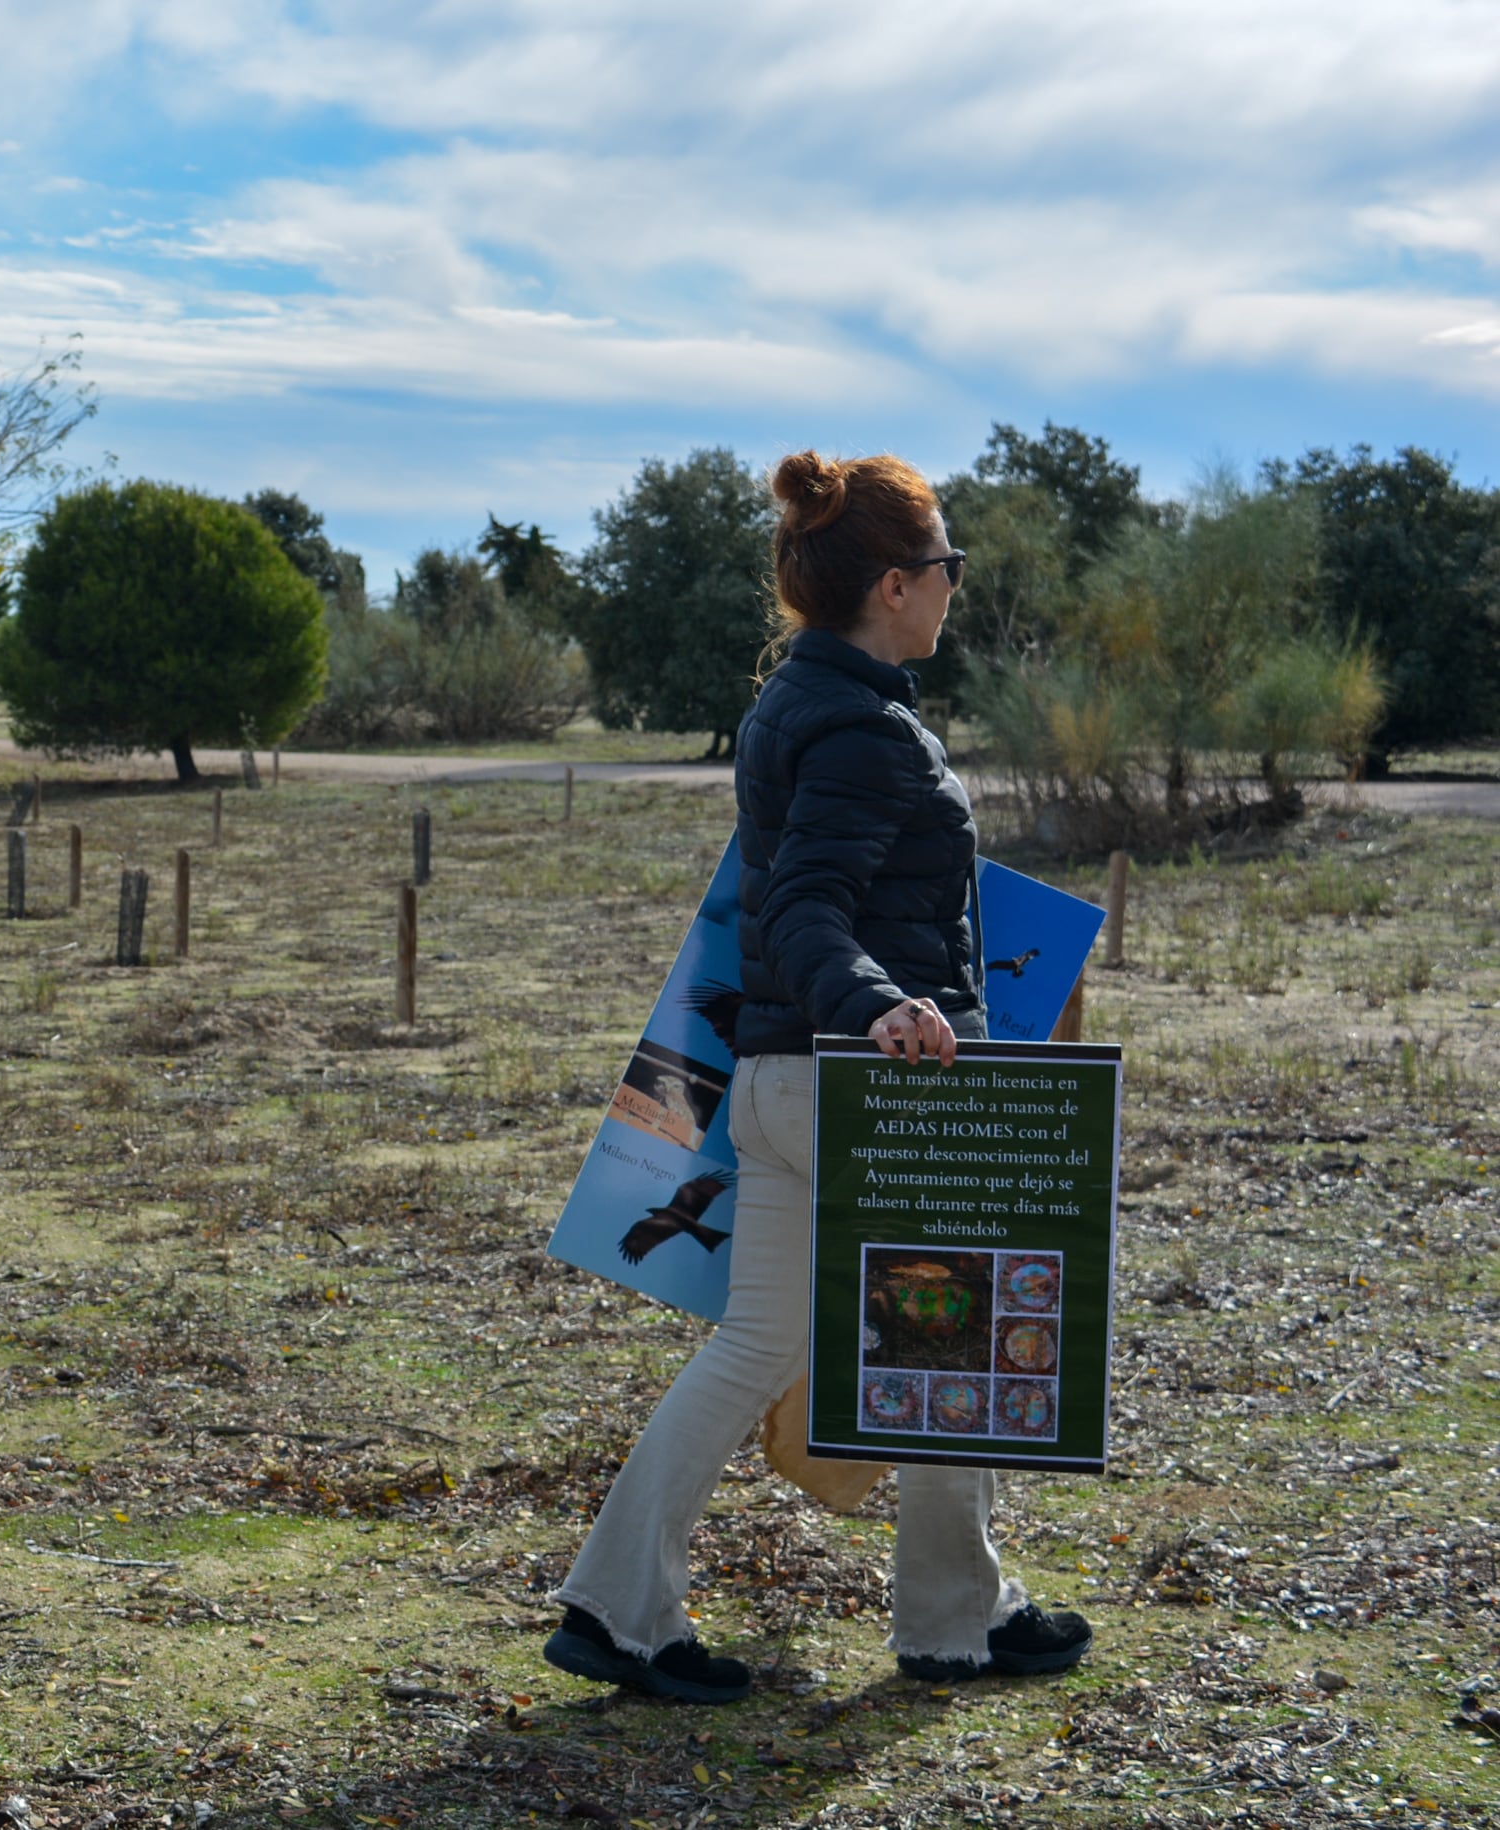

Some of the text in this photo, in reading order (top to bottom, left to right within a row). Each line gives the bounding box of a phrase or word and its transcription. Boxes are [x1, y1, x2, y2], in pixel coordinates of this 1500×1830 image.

[866, 1068, 1077, 1090] Tala masiva sin licencia en
[620, 1096, 675, 1126] Mochuelo
[864, 1095, 1078, 1116] Montegancedo a manos de
[874, 1120, 1067, 1140] AEDAS HOMES con el
[599, 1142, 676, 1182] Milano Negro
[851, 1144, 1089, 1165] supuesto desconocimiento del
[865, 1168, 1074, 1195] Ayuntamiento que dejó se
[858, 1194, 1080, 1215] talasen durante tres días más
[922, 1219, 1007, 1236] sabiéndolo
